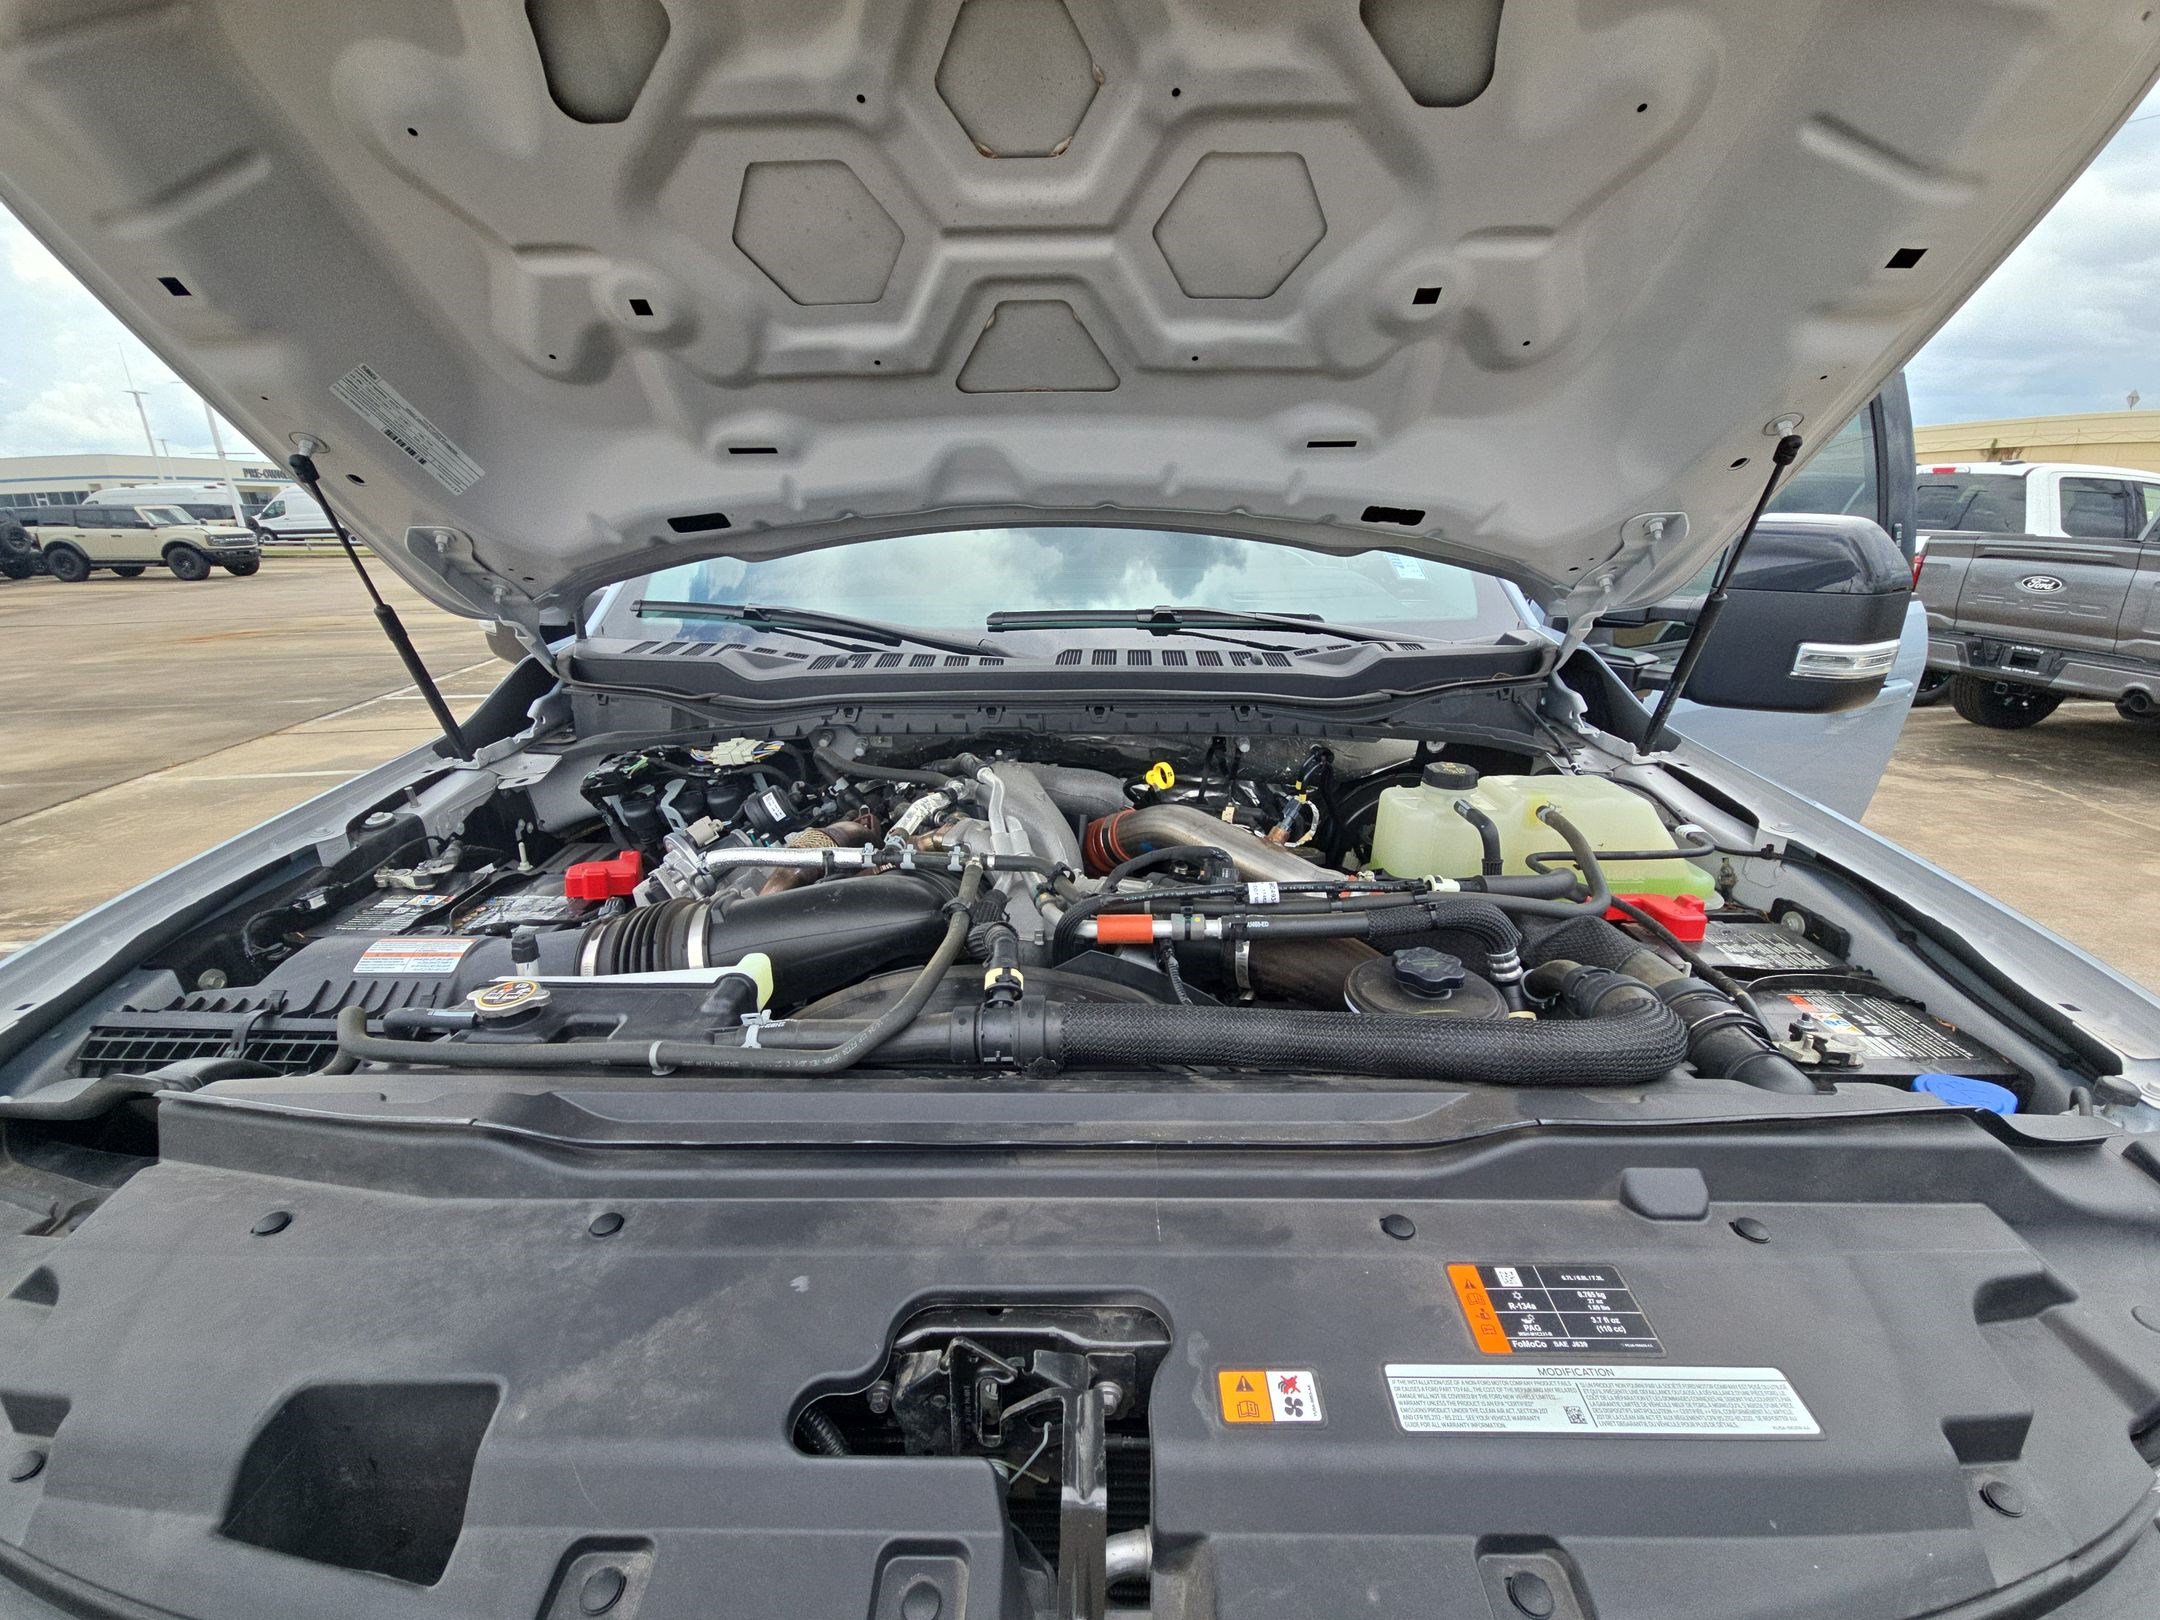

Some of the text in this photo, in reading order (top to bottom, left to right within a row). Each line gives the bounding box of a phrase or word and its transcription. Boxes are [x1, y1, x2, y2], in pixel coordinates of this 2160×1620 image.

[242, 467, 288, 479] PRE-OWN
[1508, 1302, 1537, 1310] R-134a
[1596, 1325, 1626, 1334] (110 cc)
[1537, 1368, 1615, 1376] MODIFICATION
